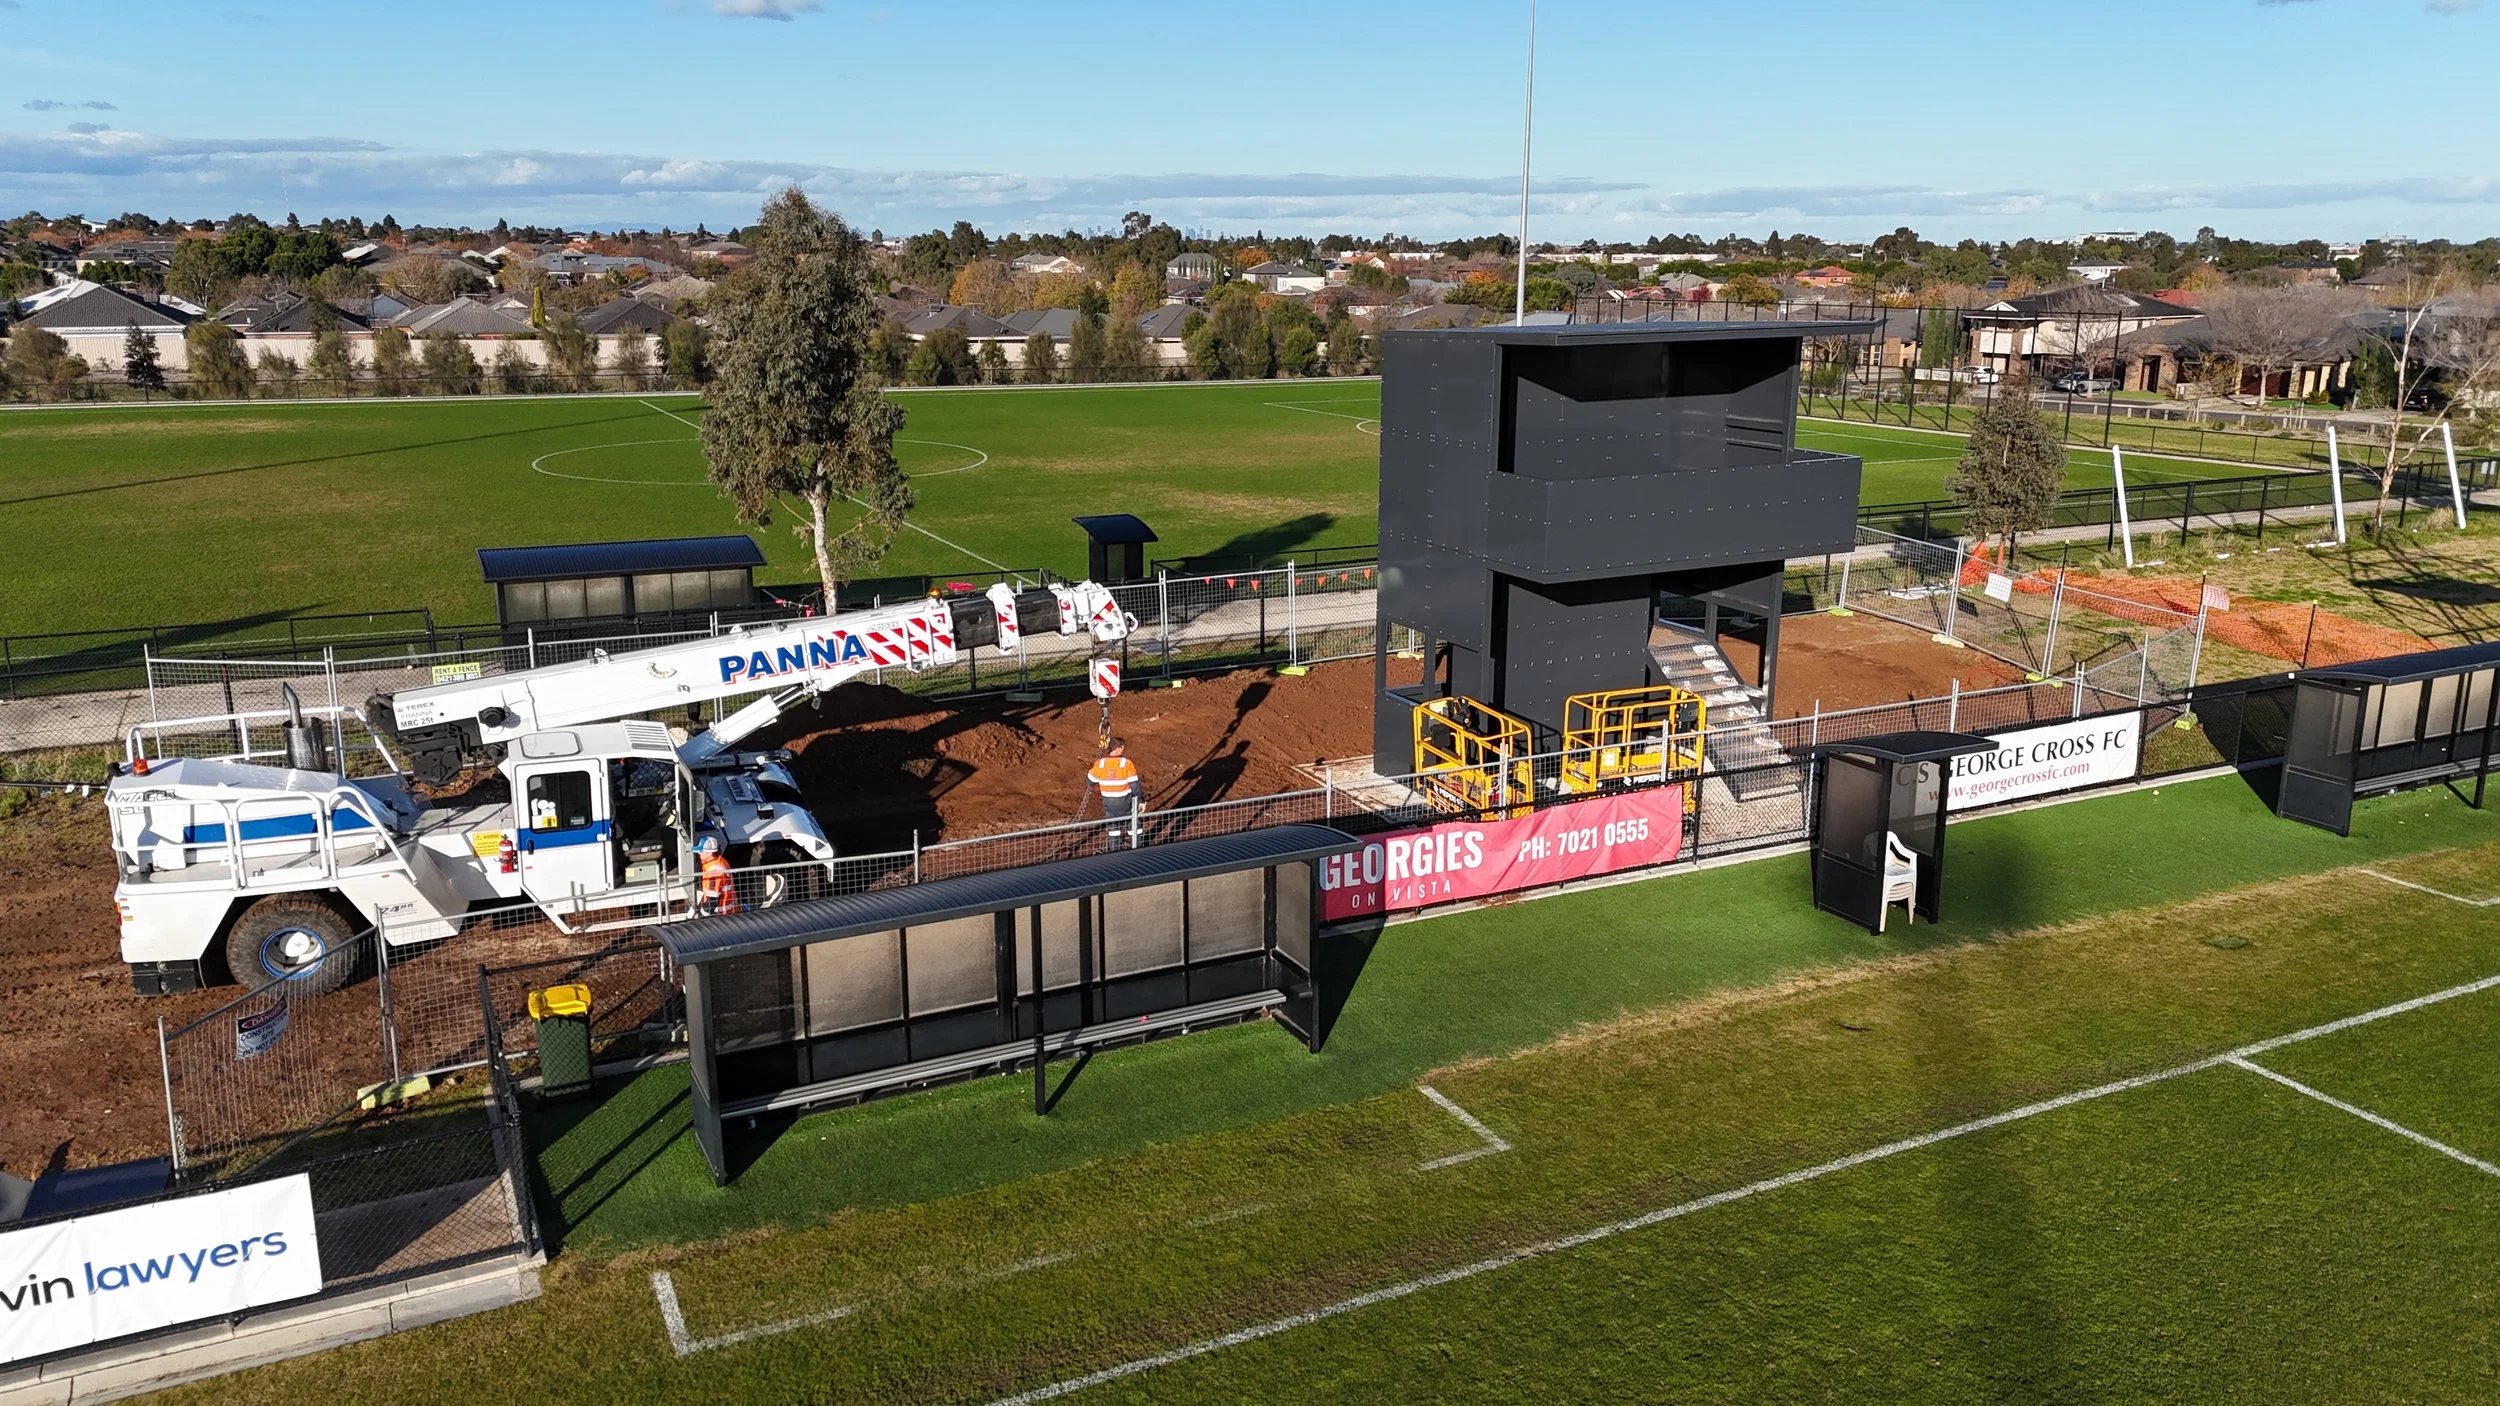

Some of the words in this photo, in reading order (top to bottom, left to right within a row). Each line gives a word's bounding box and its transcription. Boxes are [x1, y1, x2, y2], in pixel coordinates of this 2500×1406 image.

[435, 667, 451, 675] RENT
[459, 664, 478, 673] FENCE
[719, 634, 870, 684] PANNA
[400, 719, 419, 728] MRC
[421, 716, 434, 724] 25t
[406, 701, 435, 711] TEREX
[2032, 733, 2094, 763] CROSS
[2103, 728, 2128, 751] FC
[1518, 835, 1551, 862] PH:
[1558, 826, 1598, 856] 7021
[1604, 818, 1648, 847] 0555
[1319, 830, 1485, 891] GEORGIES
[1352, 892, 1376, 909] ON
[1393, 879, 1450, 902] VISTA
[241, 1010, 288, 1042] CONSTRUCT
[0, 1273, 75, 1312] vin
[84, 1231, 288, 1295] lawyers
